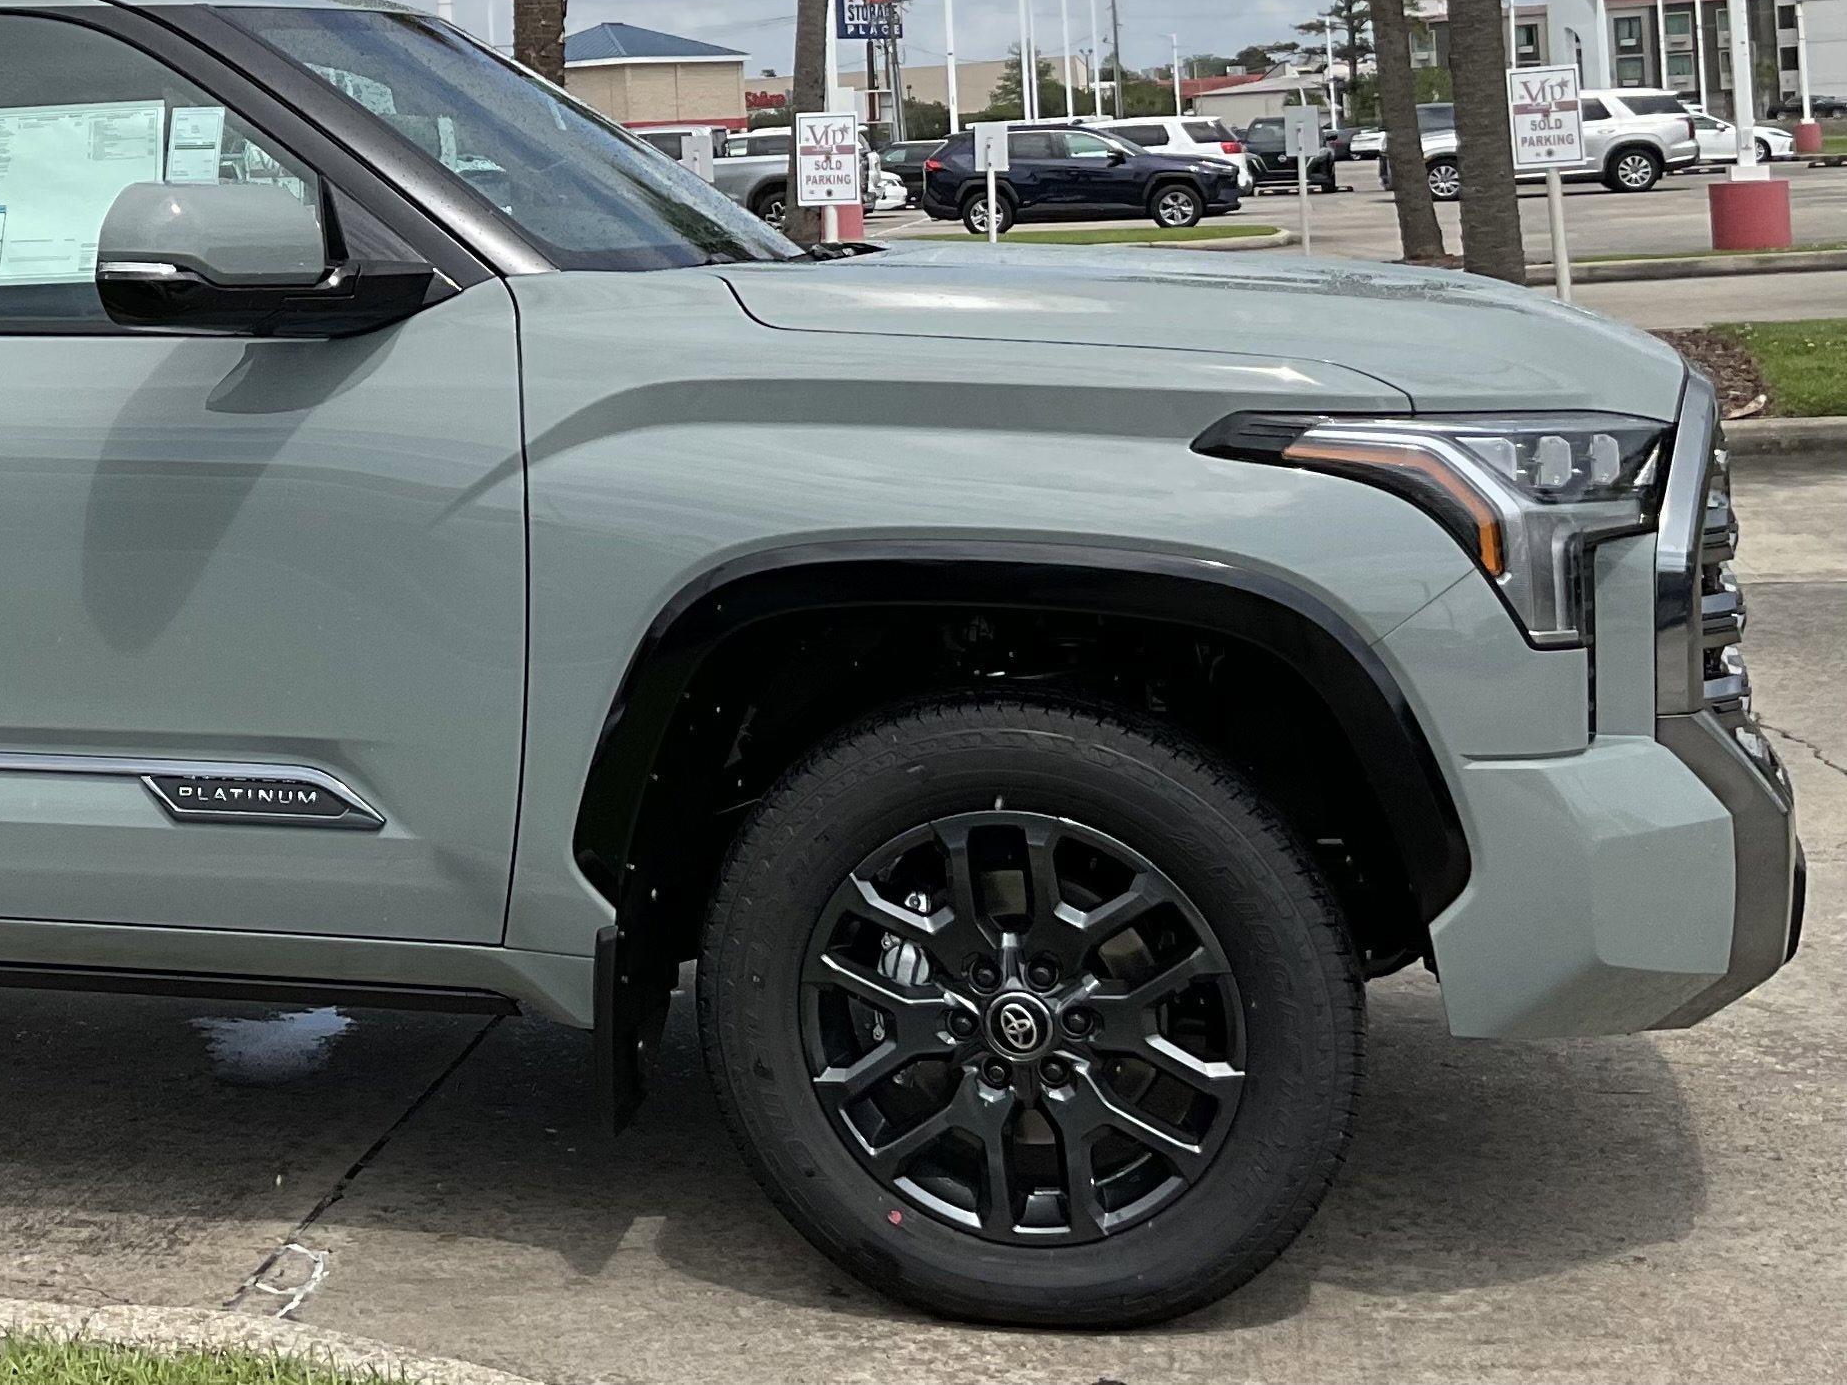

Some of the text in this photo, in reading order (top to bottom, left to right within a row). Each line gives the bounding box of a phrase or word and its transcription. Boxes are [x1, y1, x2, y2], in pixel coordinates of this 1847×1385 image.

[847, 24, 900, 35] PLACE
[1530, 118, 1563, 131] SOLD
[1520, 133, 1575, 147] PARKING
[814, 160, 842, 170] SOLD
[805, 174, 852, 185] PARKING
[178, 786, 317, 804] PLATINUM
